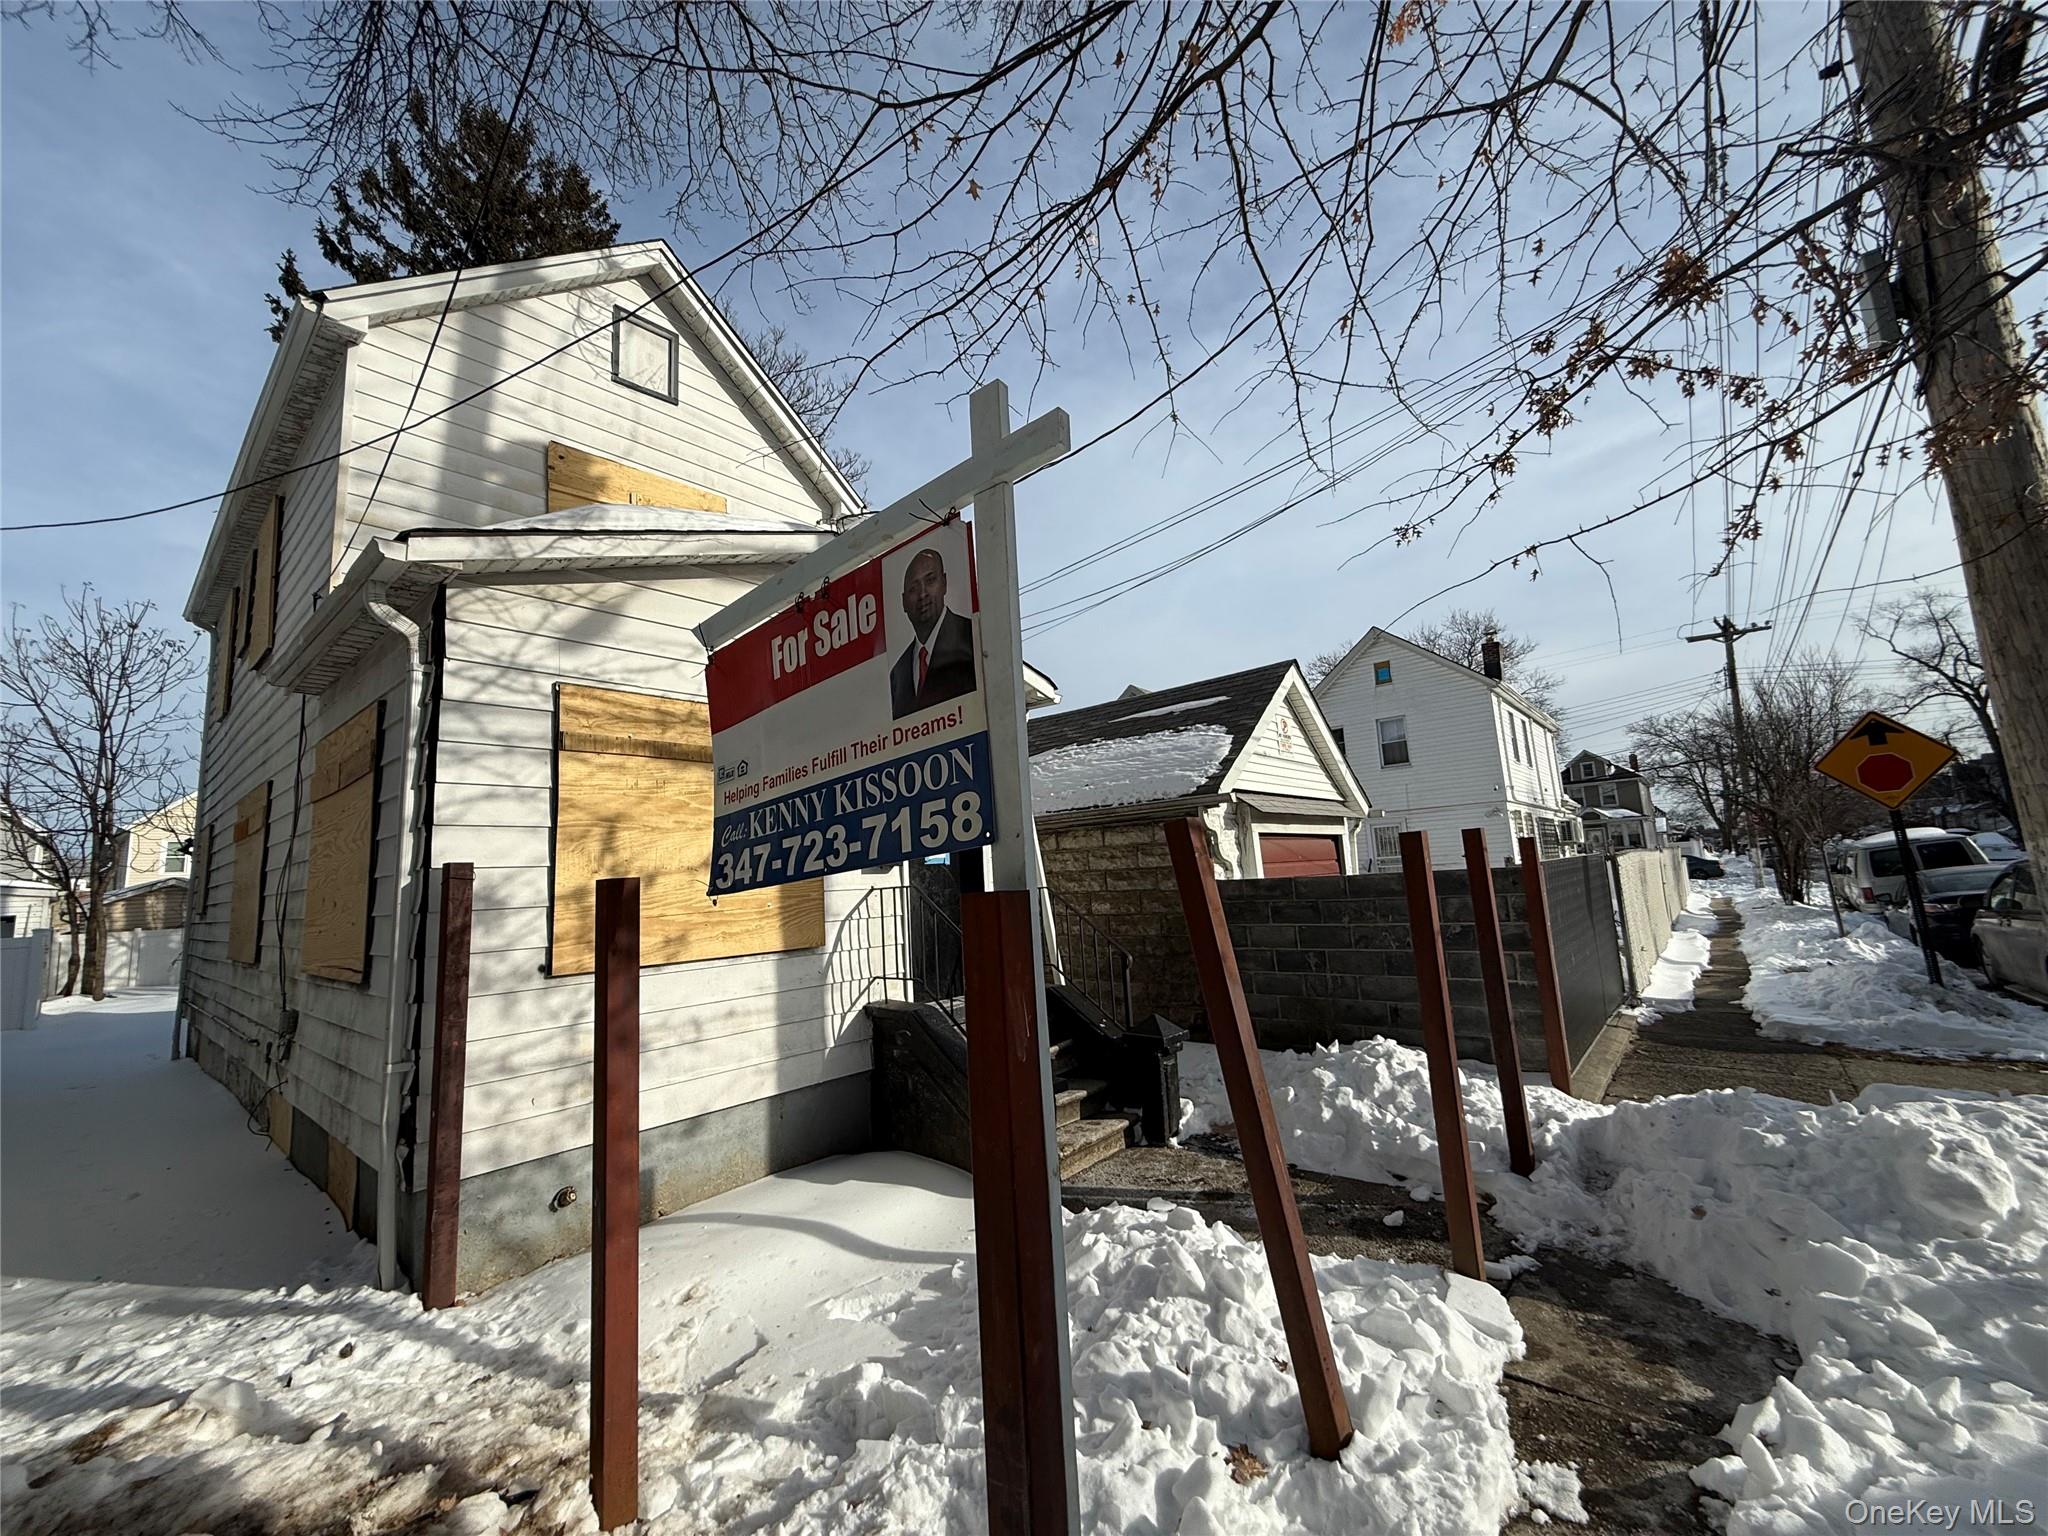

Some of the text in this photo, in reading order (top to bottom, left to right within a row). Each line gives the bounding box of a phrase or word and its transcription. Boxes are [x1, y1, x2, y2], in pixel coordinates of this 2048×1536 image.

[771, 593, 877, 680] For Sale
[721, 743, 975, 848] Call: KENNY KISSOON
[723, 705, 963, 805] Helping Families Fulfill Their Dreams!
[715, 791, 983, 890] 347-723-7158
